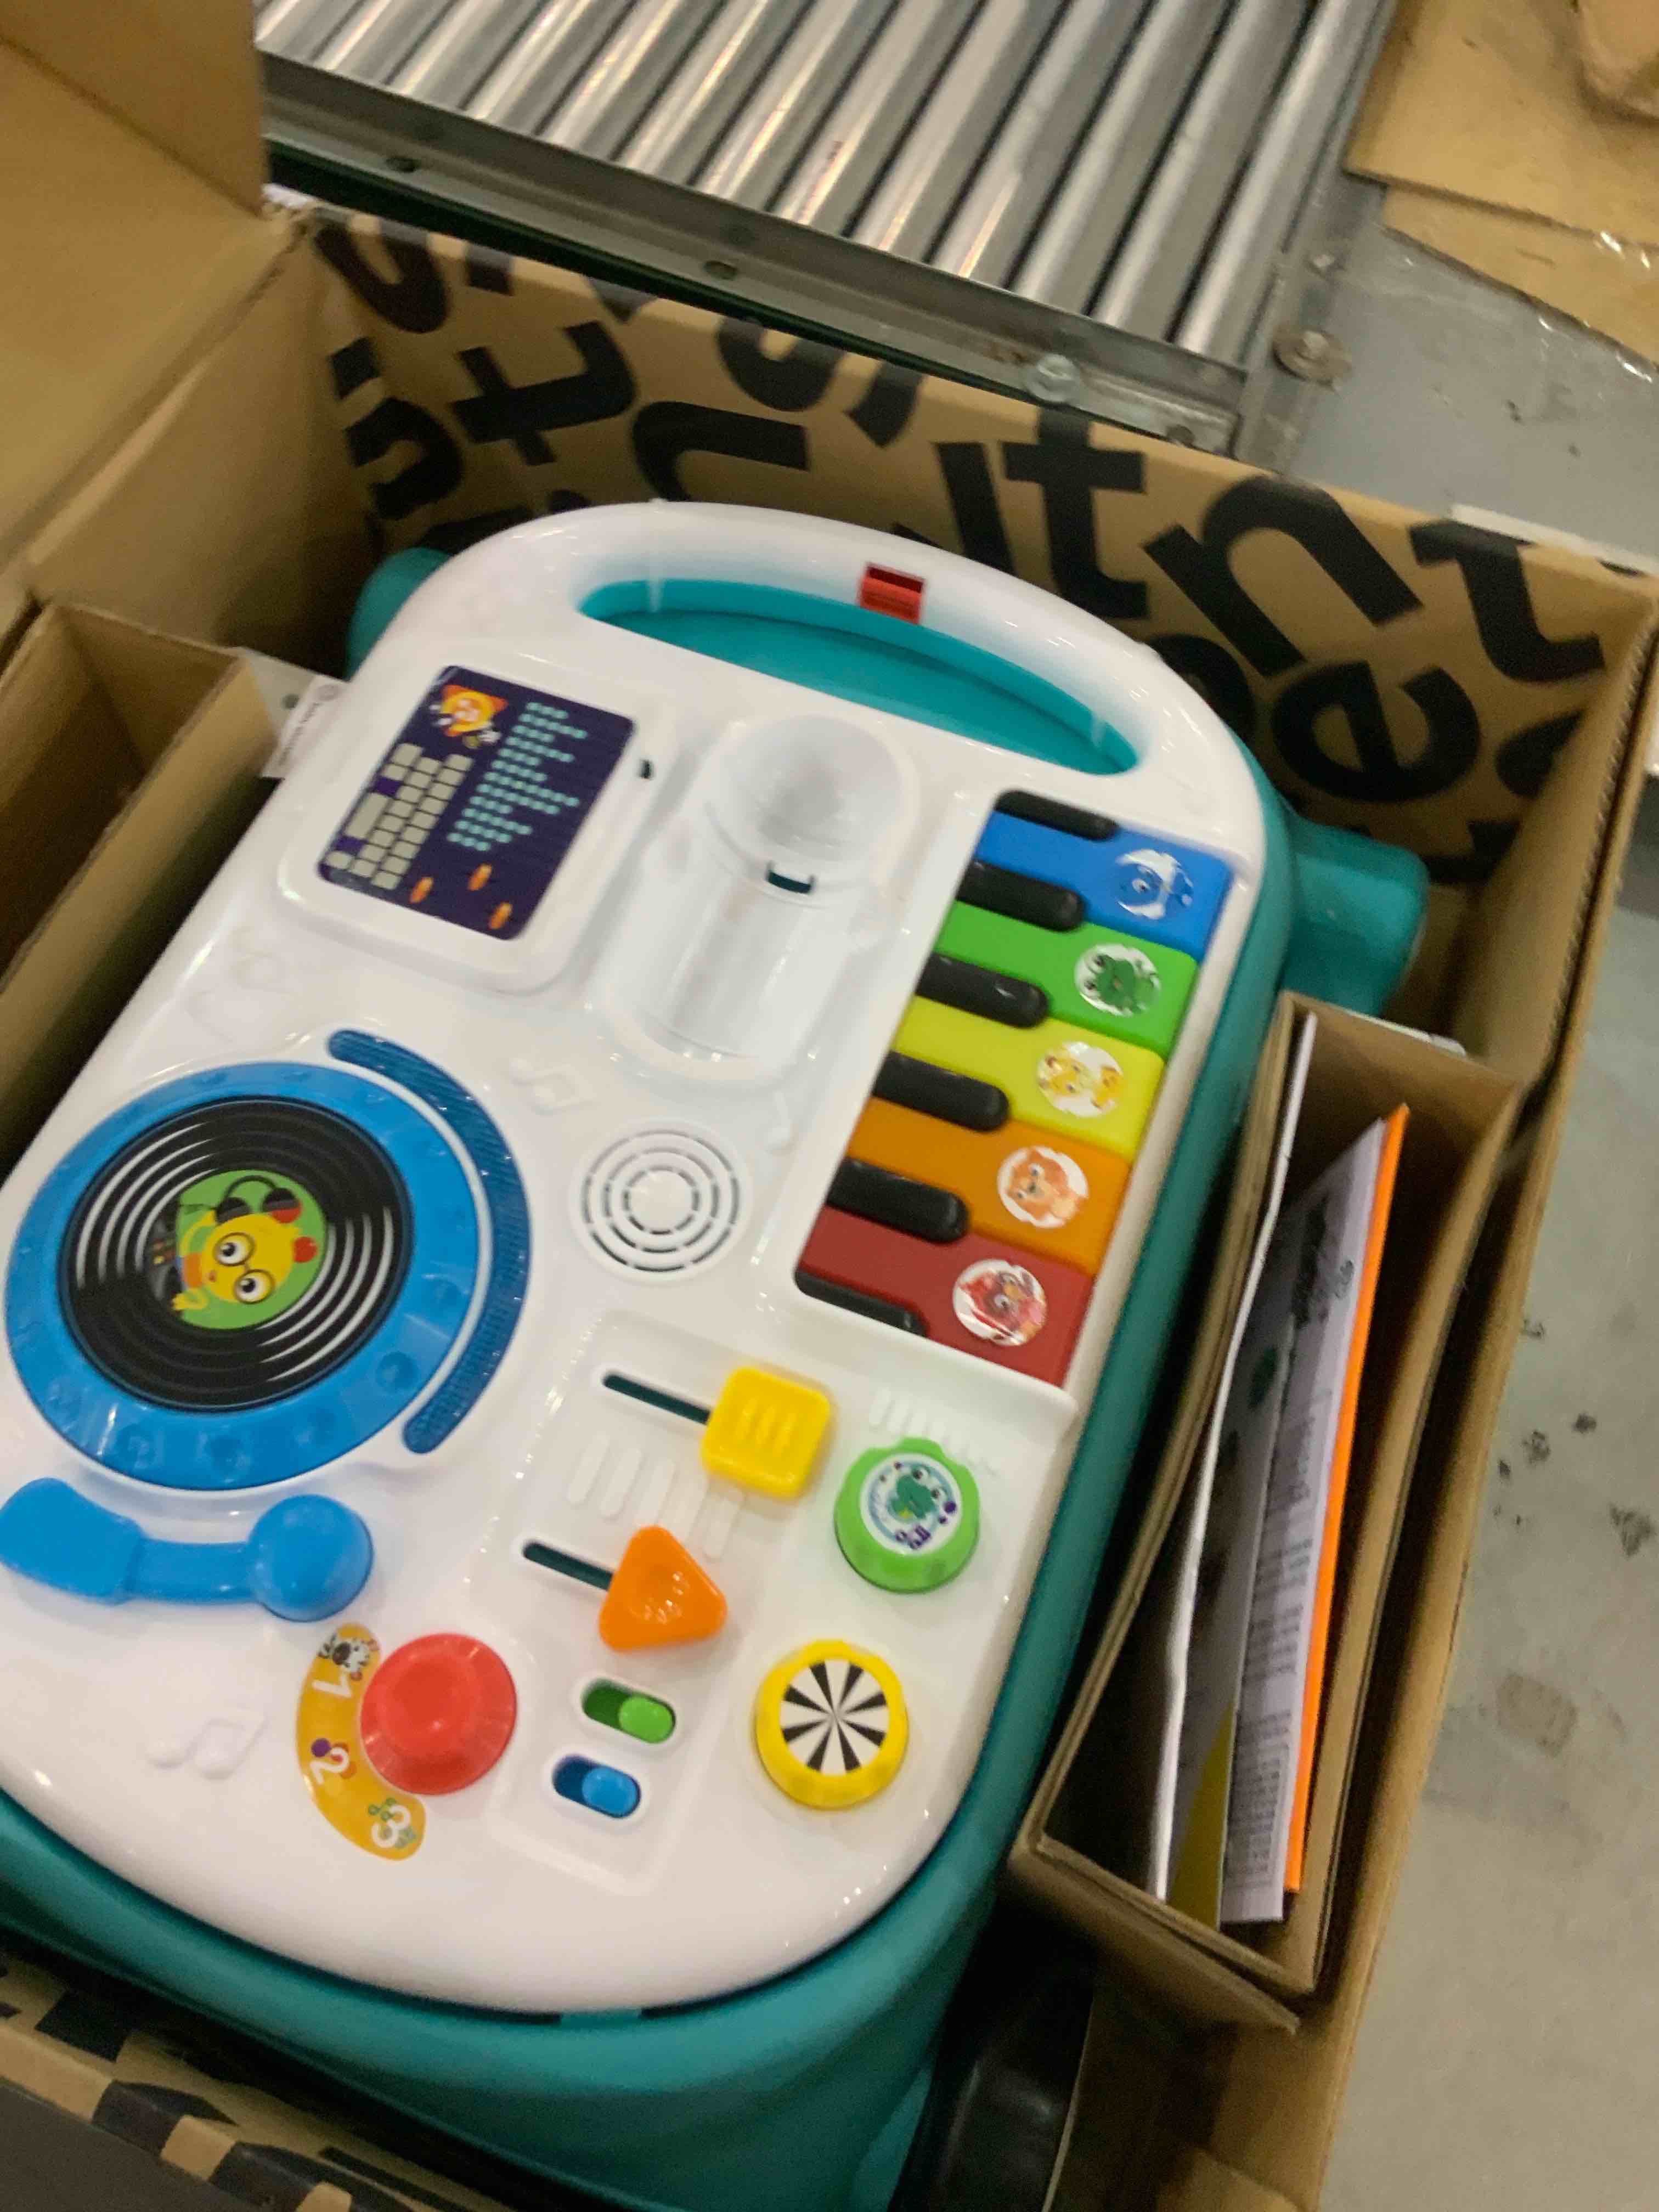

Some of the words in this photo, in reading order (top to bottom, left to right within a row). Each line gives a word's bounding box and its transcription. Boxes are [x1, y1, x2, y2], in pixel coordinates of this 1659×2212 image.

[312, 1673, 353, 1697] 1
[309, 1746, 350, 1785] 2
[371, 1804, 411, 1848] 3
